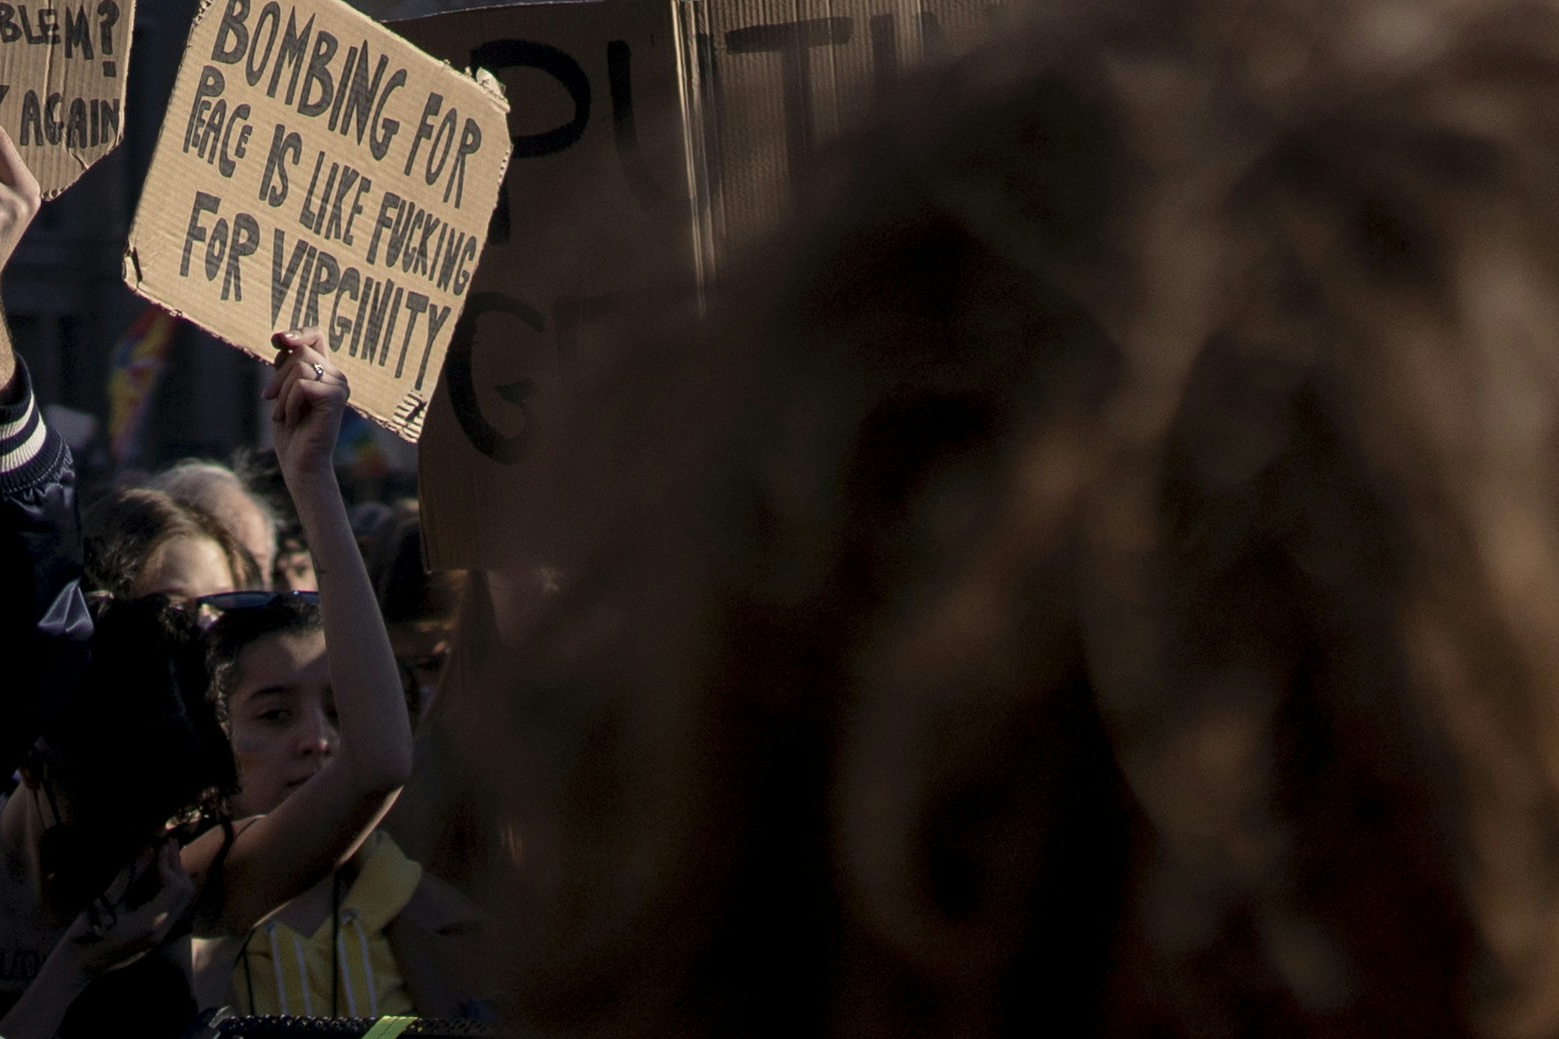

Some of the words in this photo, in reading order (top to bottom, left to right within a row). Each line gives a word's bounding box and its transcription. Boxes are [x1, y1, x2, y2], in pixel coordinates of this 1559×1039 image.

[19, 89, 120, 148] AGAIN
[182, 65, 253, 178] PEACE
[259, 124, 302, 208] IS
[299, 151, 371, 247] LIKE
[367, 191, 477, 297] FUCKING
[403, 91, 482, 209] FOR
[180, 191, 260, 303] FOR
[271, 228, 451, 391] VIRGINITY
